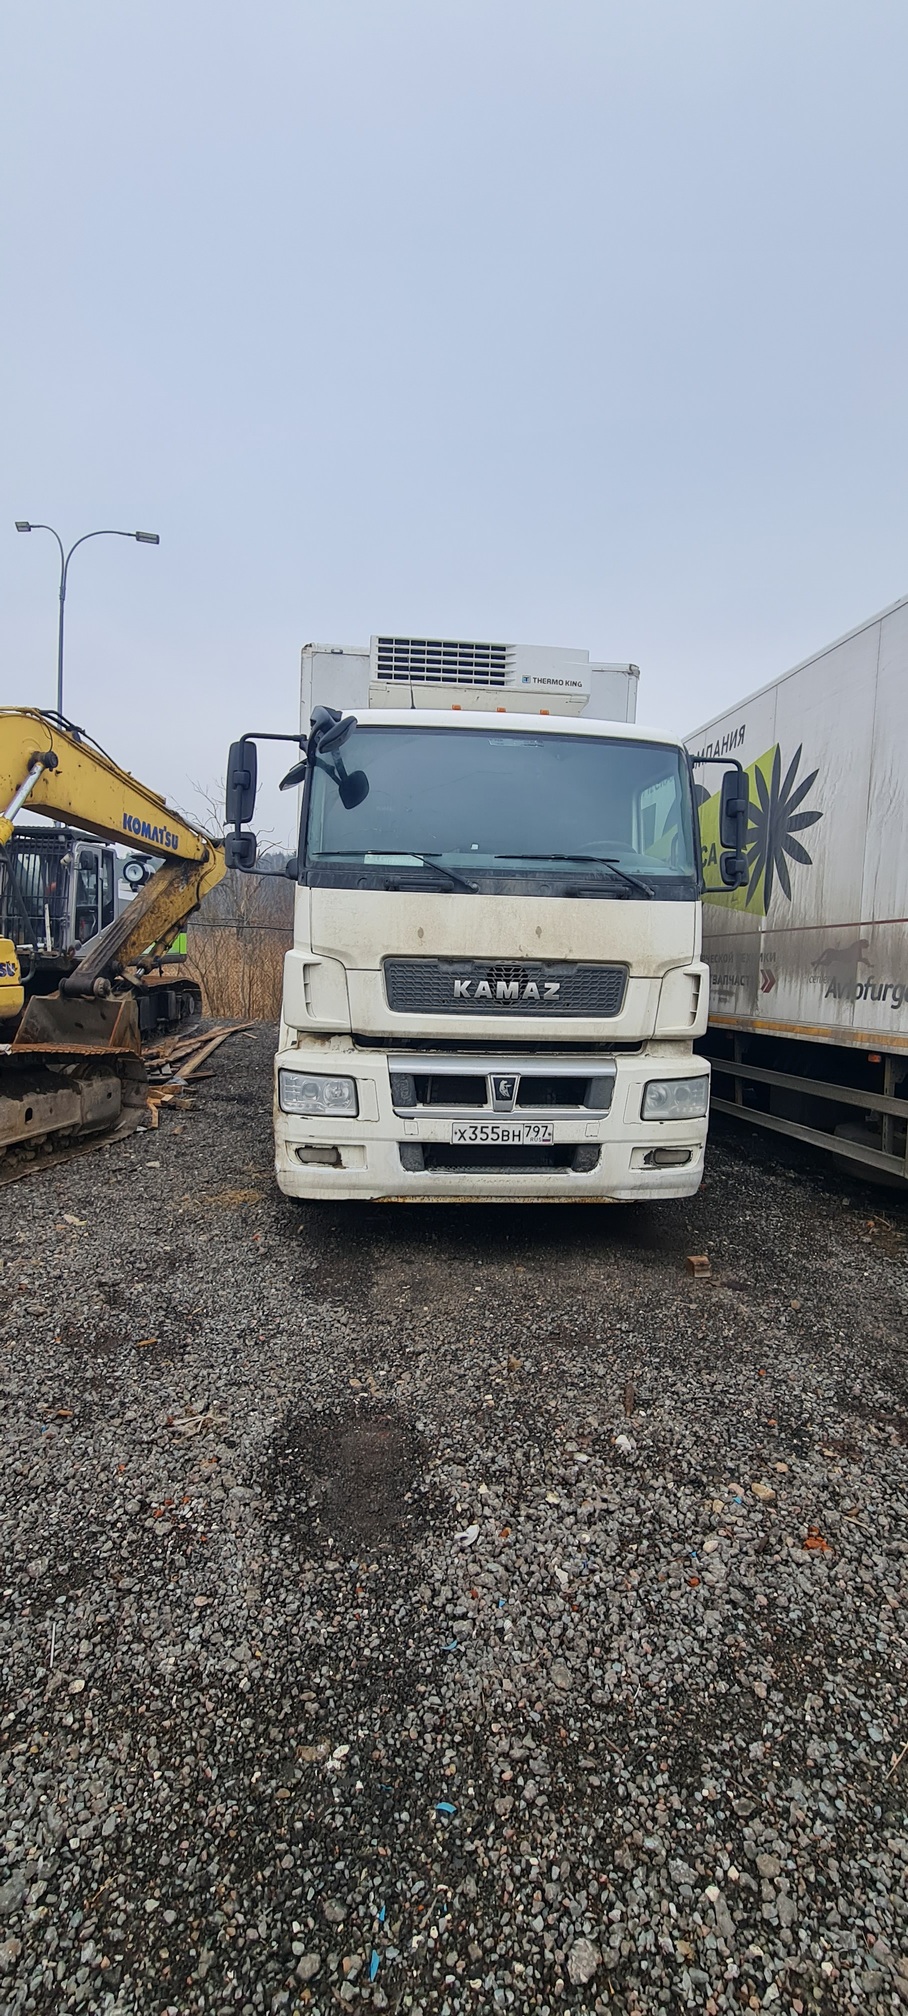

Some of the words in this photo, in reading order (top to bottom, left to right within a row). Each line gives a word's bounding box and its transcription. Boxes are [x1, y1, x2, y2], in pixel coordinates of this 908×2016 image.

[533, 677, 564, 686] THERMO
[565, 680, 582, 688] KING
[693, 724, 746, 769] МПАНИЯ
[122, 812, 179, 850] KOMATSU
[453, 979, 560, 1000] KAMAZ
[712, 974, 757, 987] ЗАПЧАСТ
[457, 1125, 521, 1142] Х355ВН
[525, 1125, 548, 1138] 797
